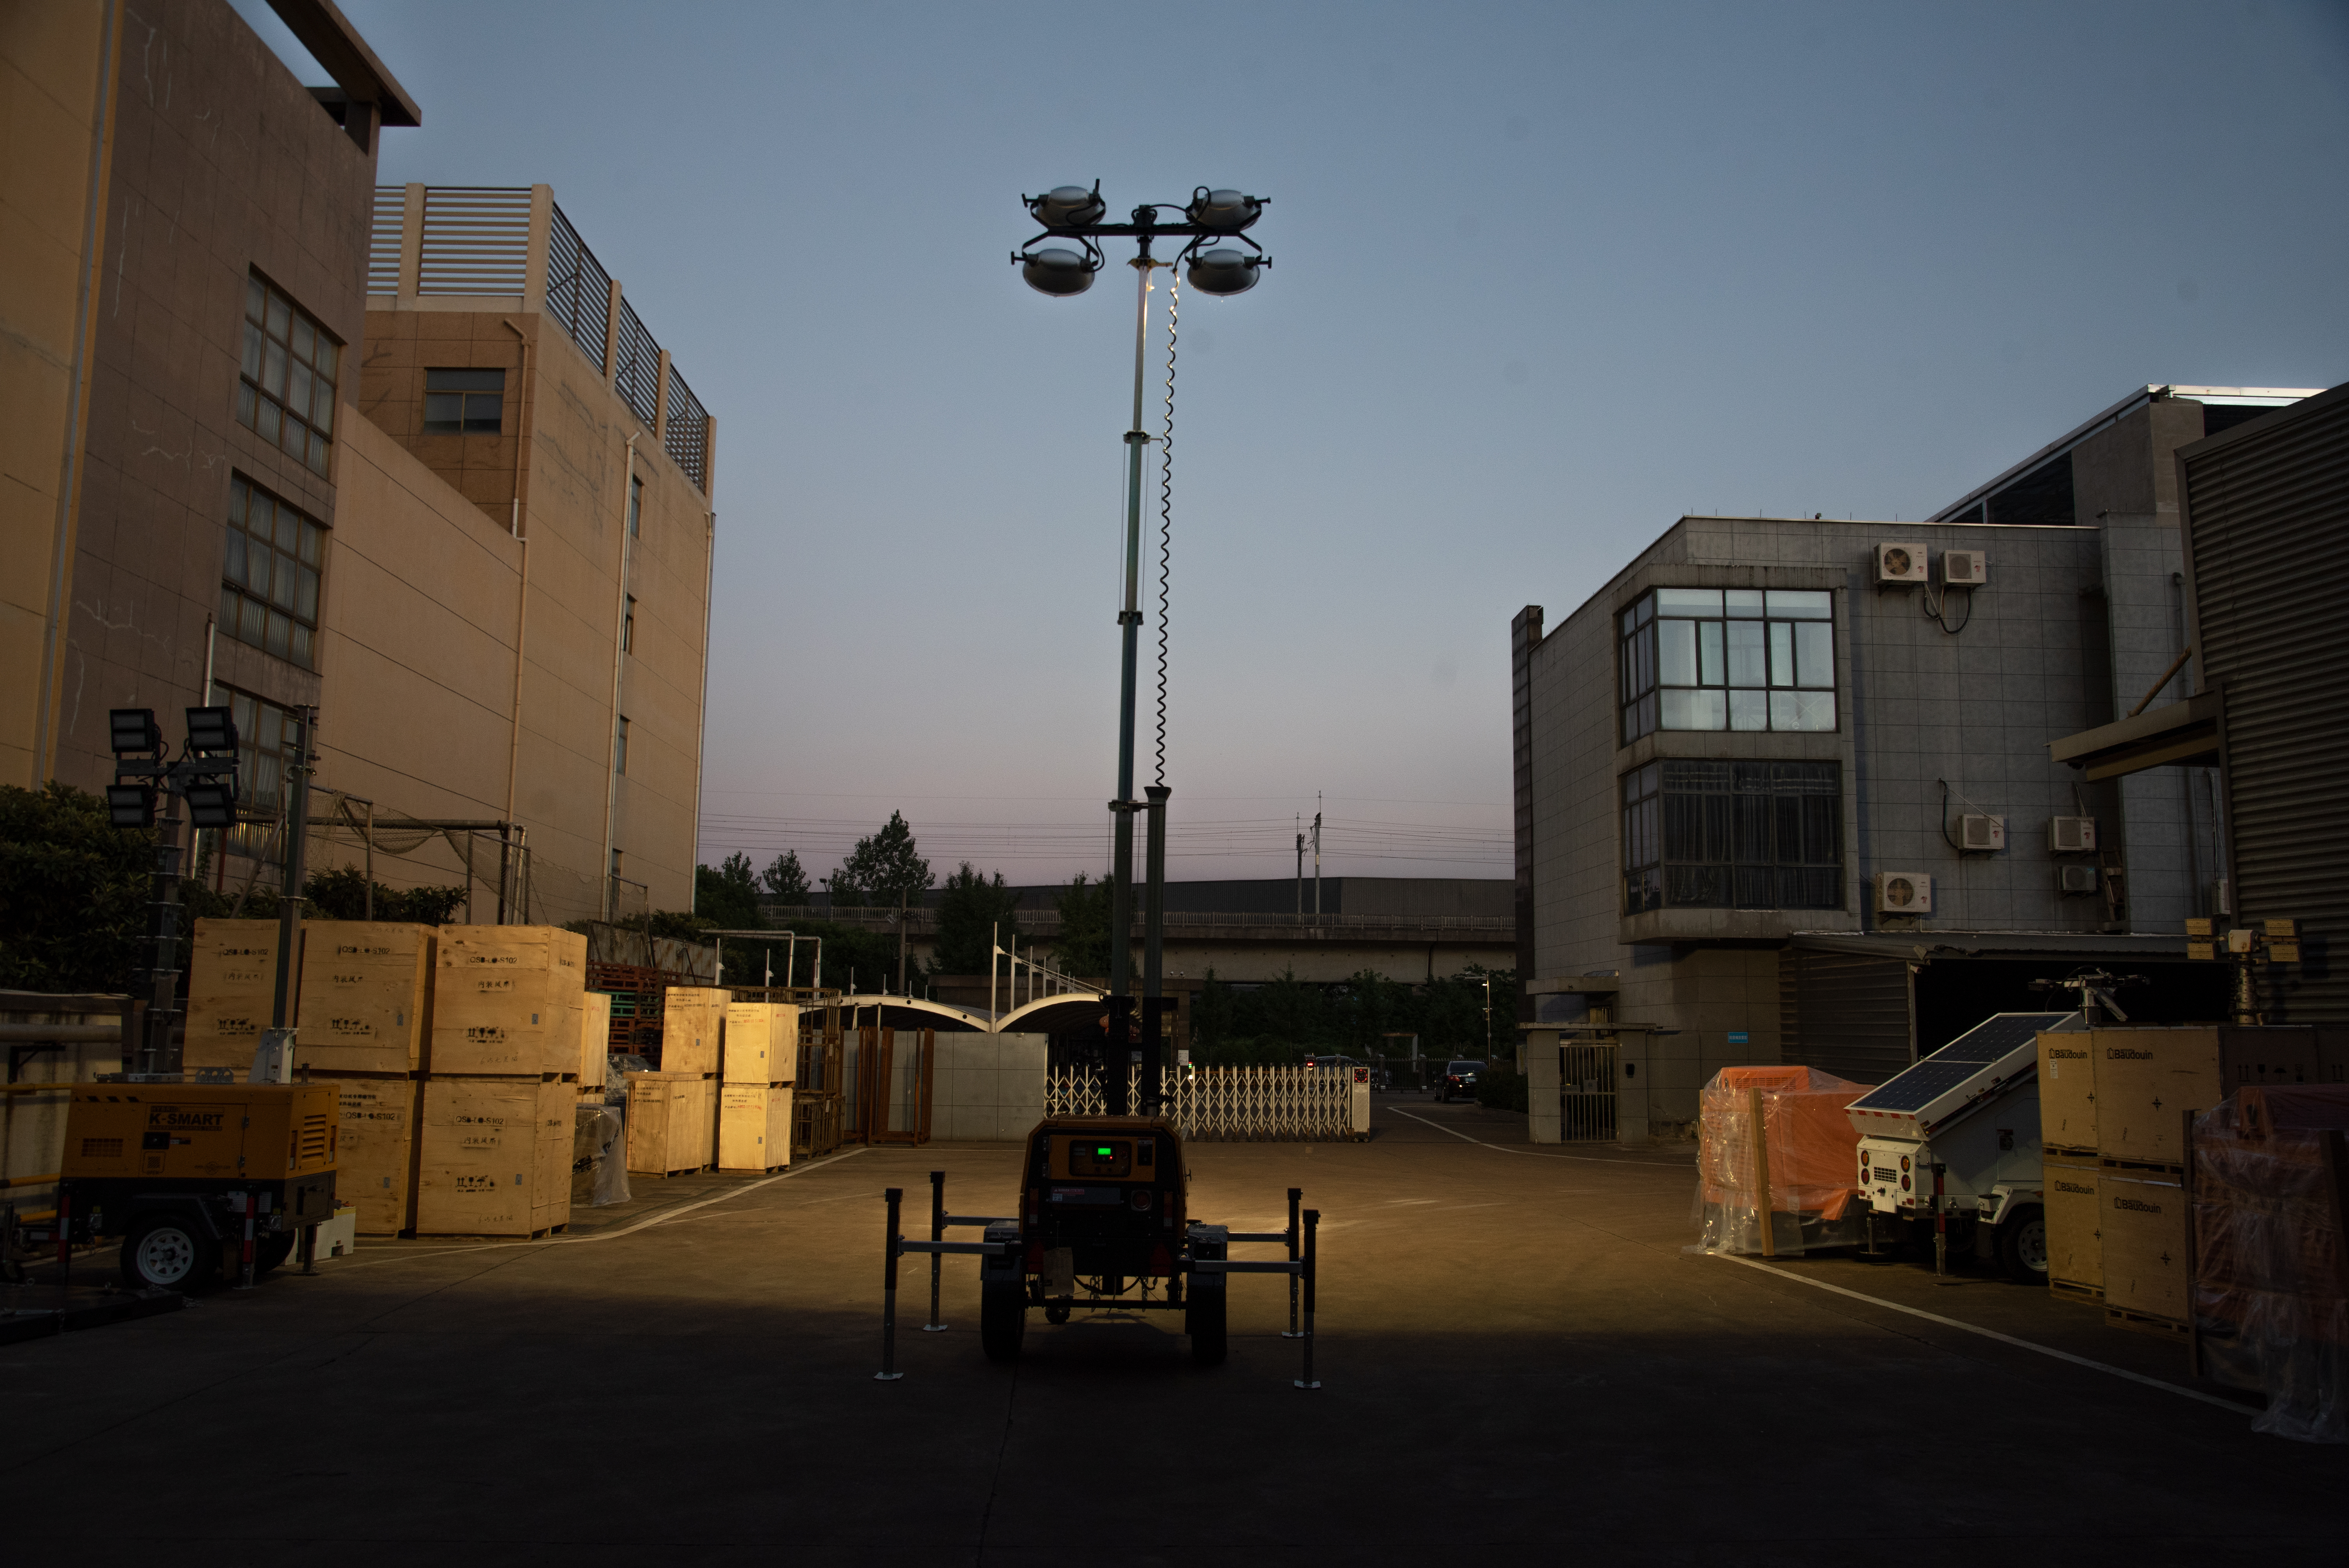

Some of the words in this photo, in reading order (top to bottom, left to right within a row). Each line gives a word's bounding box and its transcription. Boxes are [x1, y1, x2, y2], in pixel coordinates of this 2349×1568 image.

[2055, 1049, 2087, 1059] Baudouin
[2114, 1049, 2153, 1060] Baudouin
[149, 1113, 224, 1125] K-SMART
[2061, 1182, 2094, 1195] Baudouin
[2122, 1199, 2161, 1214] Baudouin
